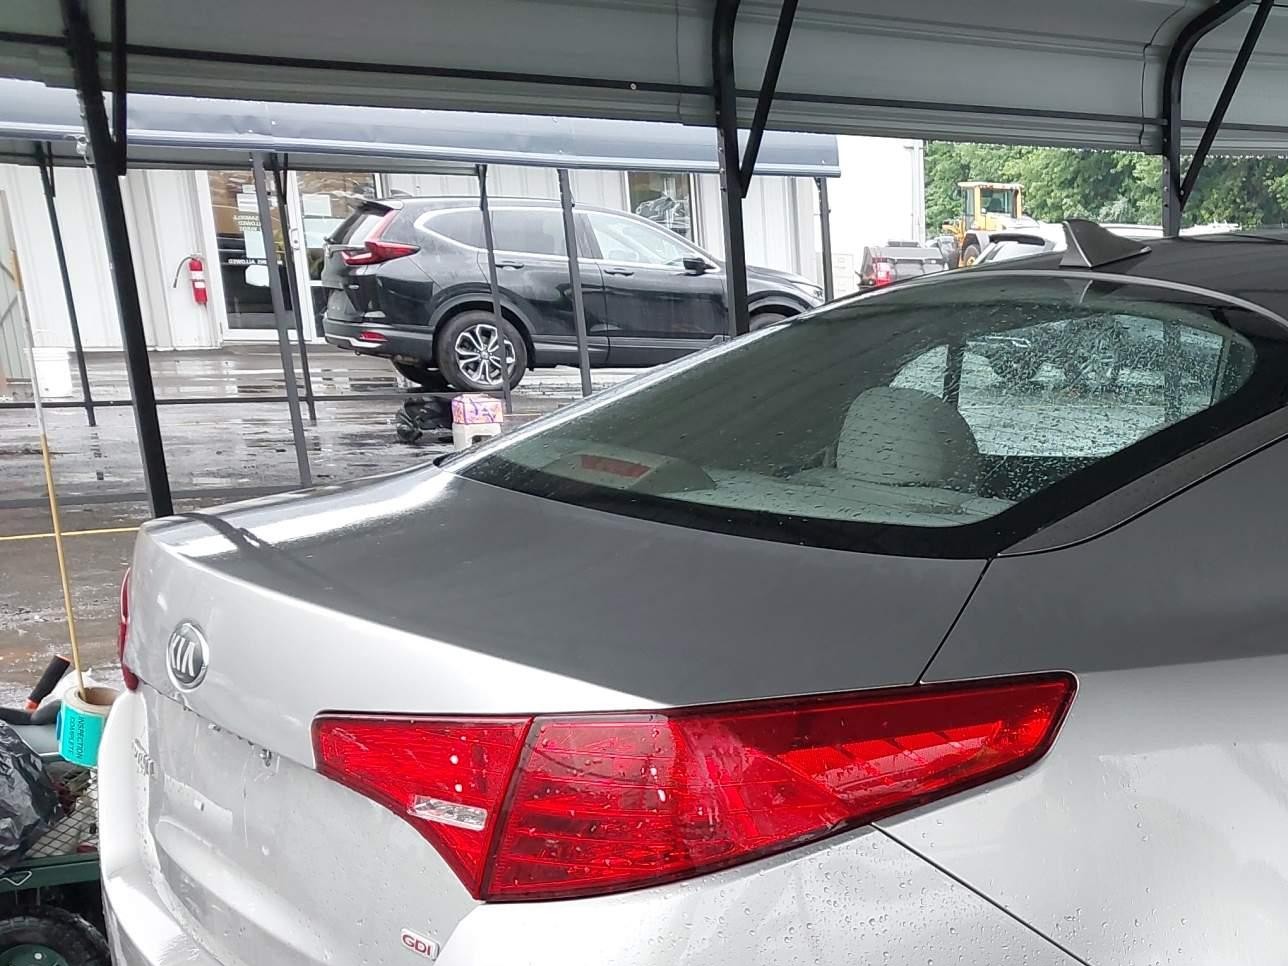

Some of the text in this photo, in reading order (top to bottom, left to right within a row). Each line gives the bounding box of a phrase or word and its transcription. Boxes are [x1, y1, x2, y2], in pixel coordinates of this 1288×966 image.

[172, 632, 196, 677] KIA
[77, 715, 85, 760] INSPECTION
[402, 934, 431, 956] GDI
